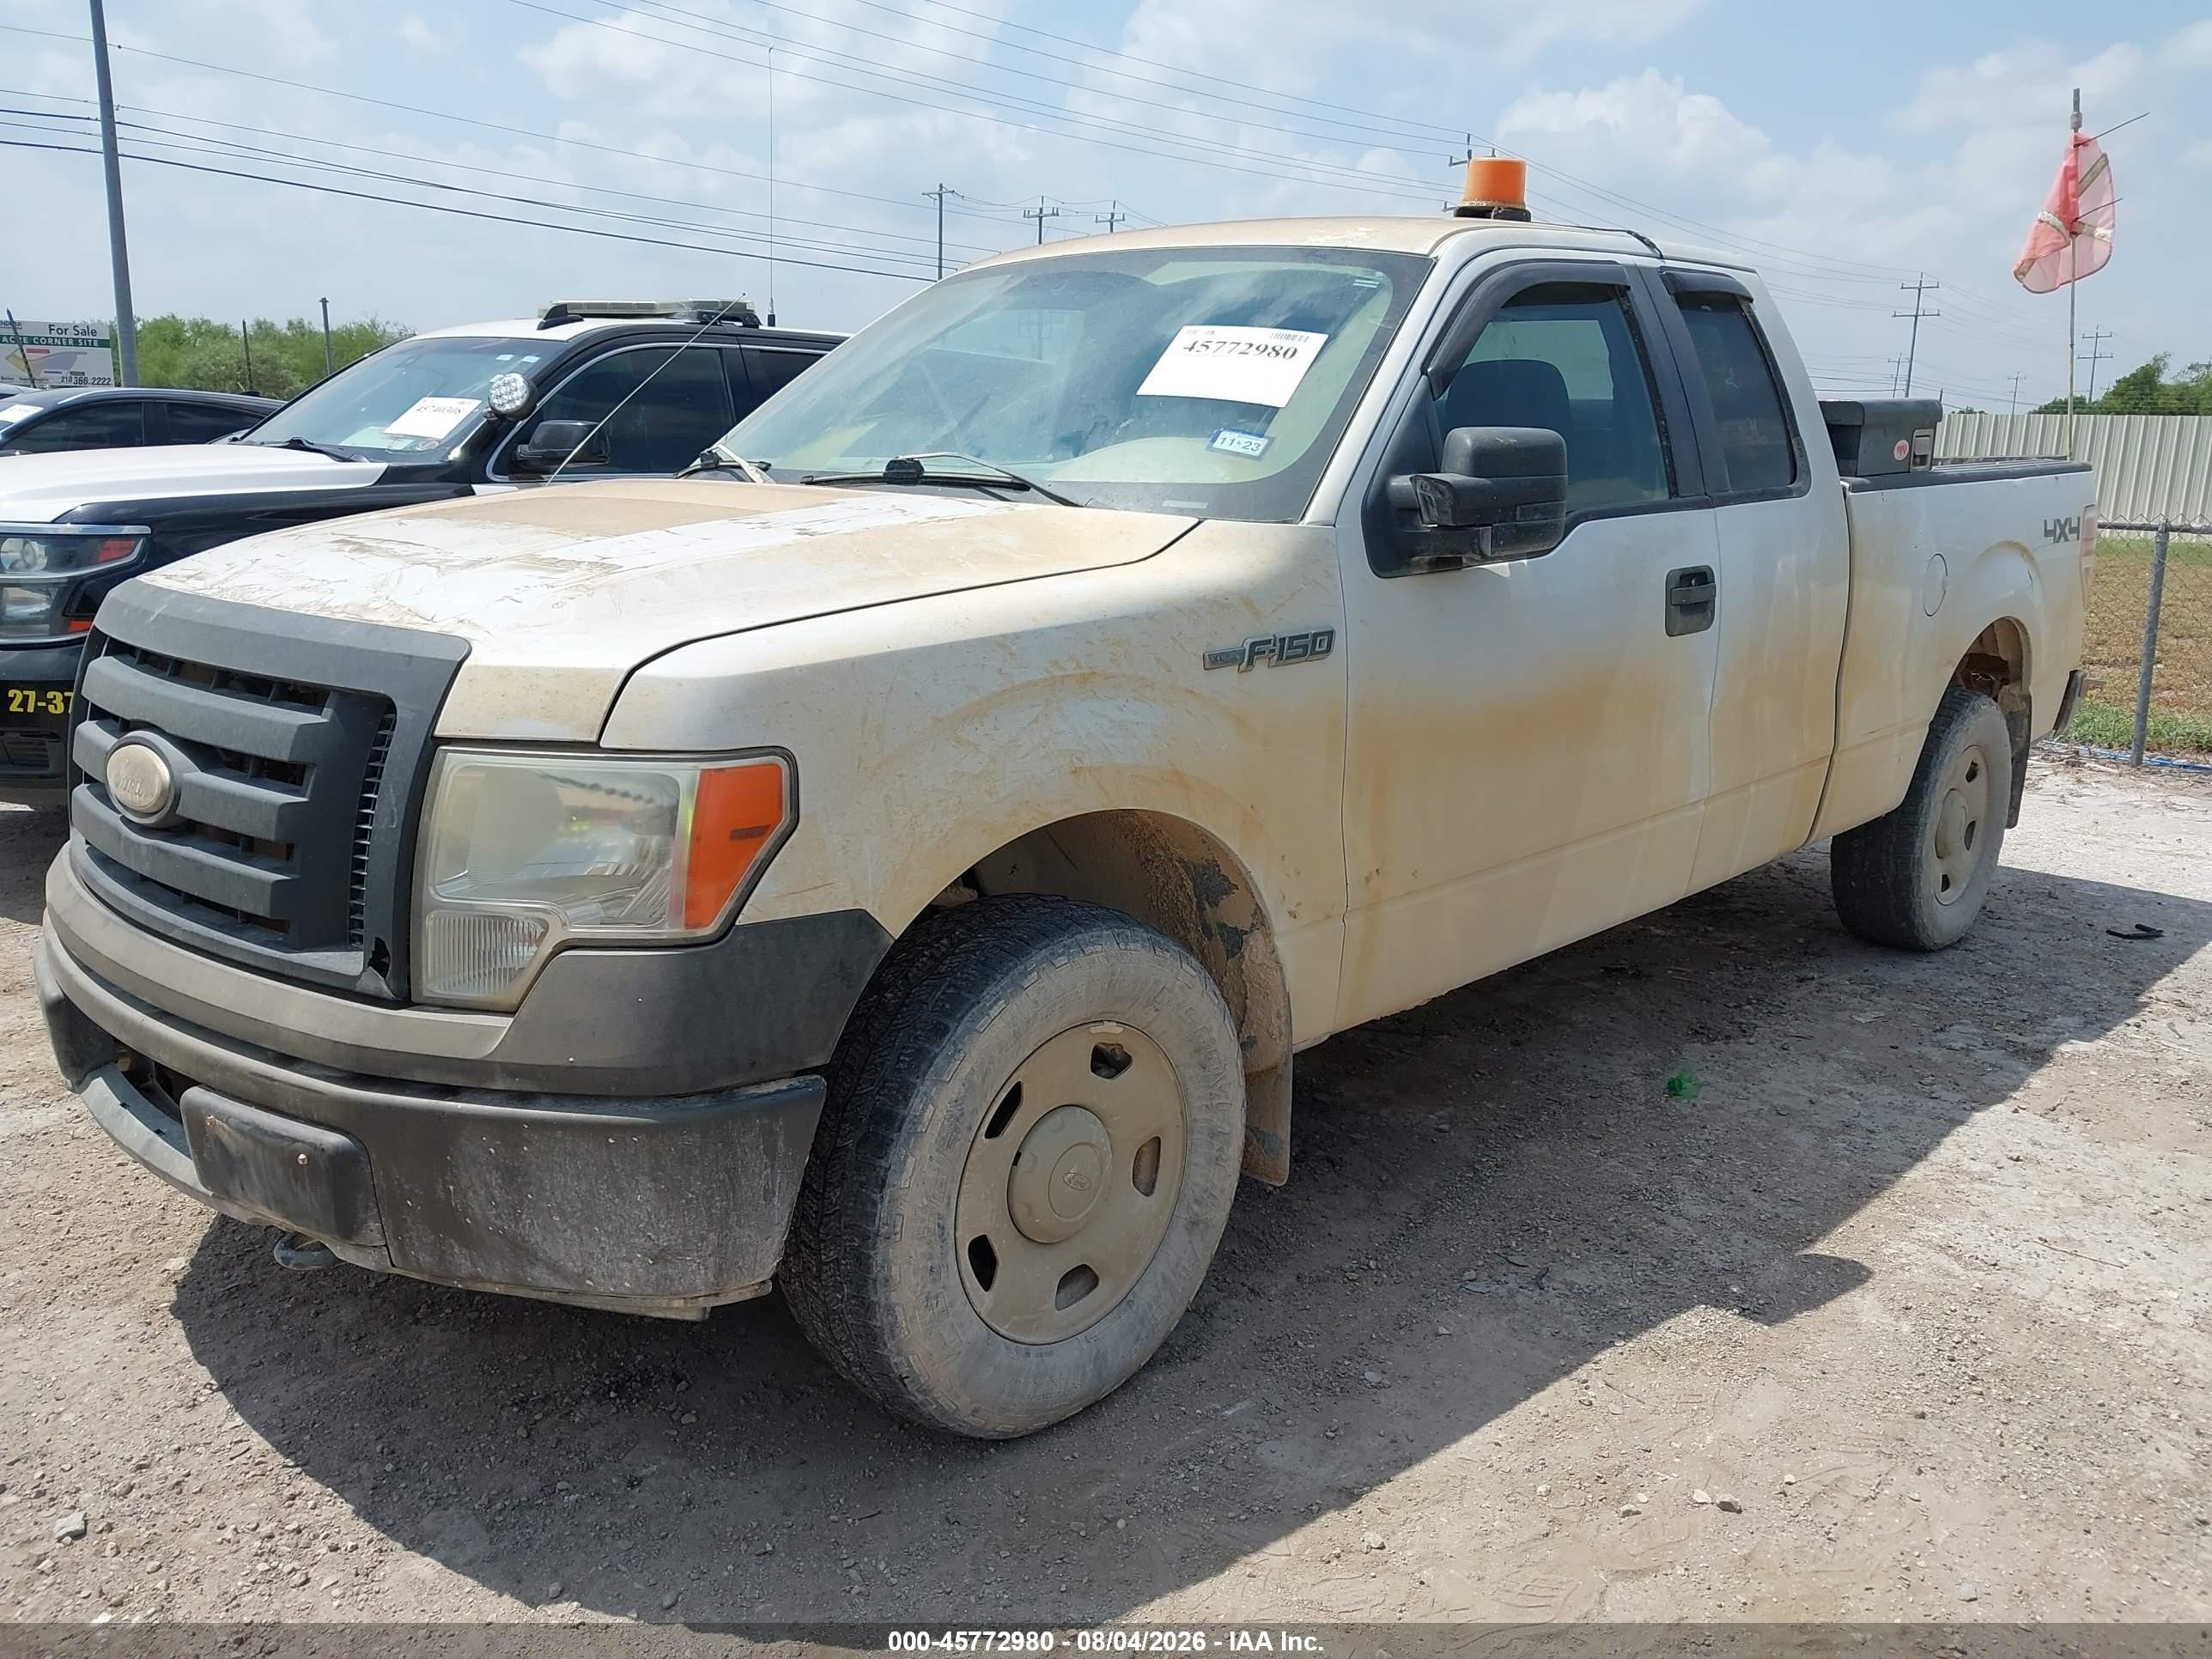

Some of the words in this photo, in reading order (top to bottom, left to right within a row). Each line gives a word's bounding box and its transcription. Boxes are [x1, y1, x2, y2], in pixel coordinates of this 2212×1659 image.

[48, 325, 69, 335] For
[73, 325, 97, 337] Sale
[33, 337, 74, 345] CORNER
[1182, 340, 1298, 360] 45772980
[73, 376, 112, 386] 366.2222
[2044, 516, 2081, 544] 4X4
[1239, 628, 1335, 670] F-150
